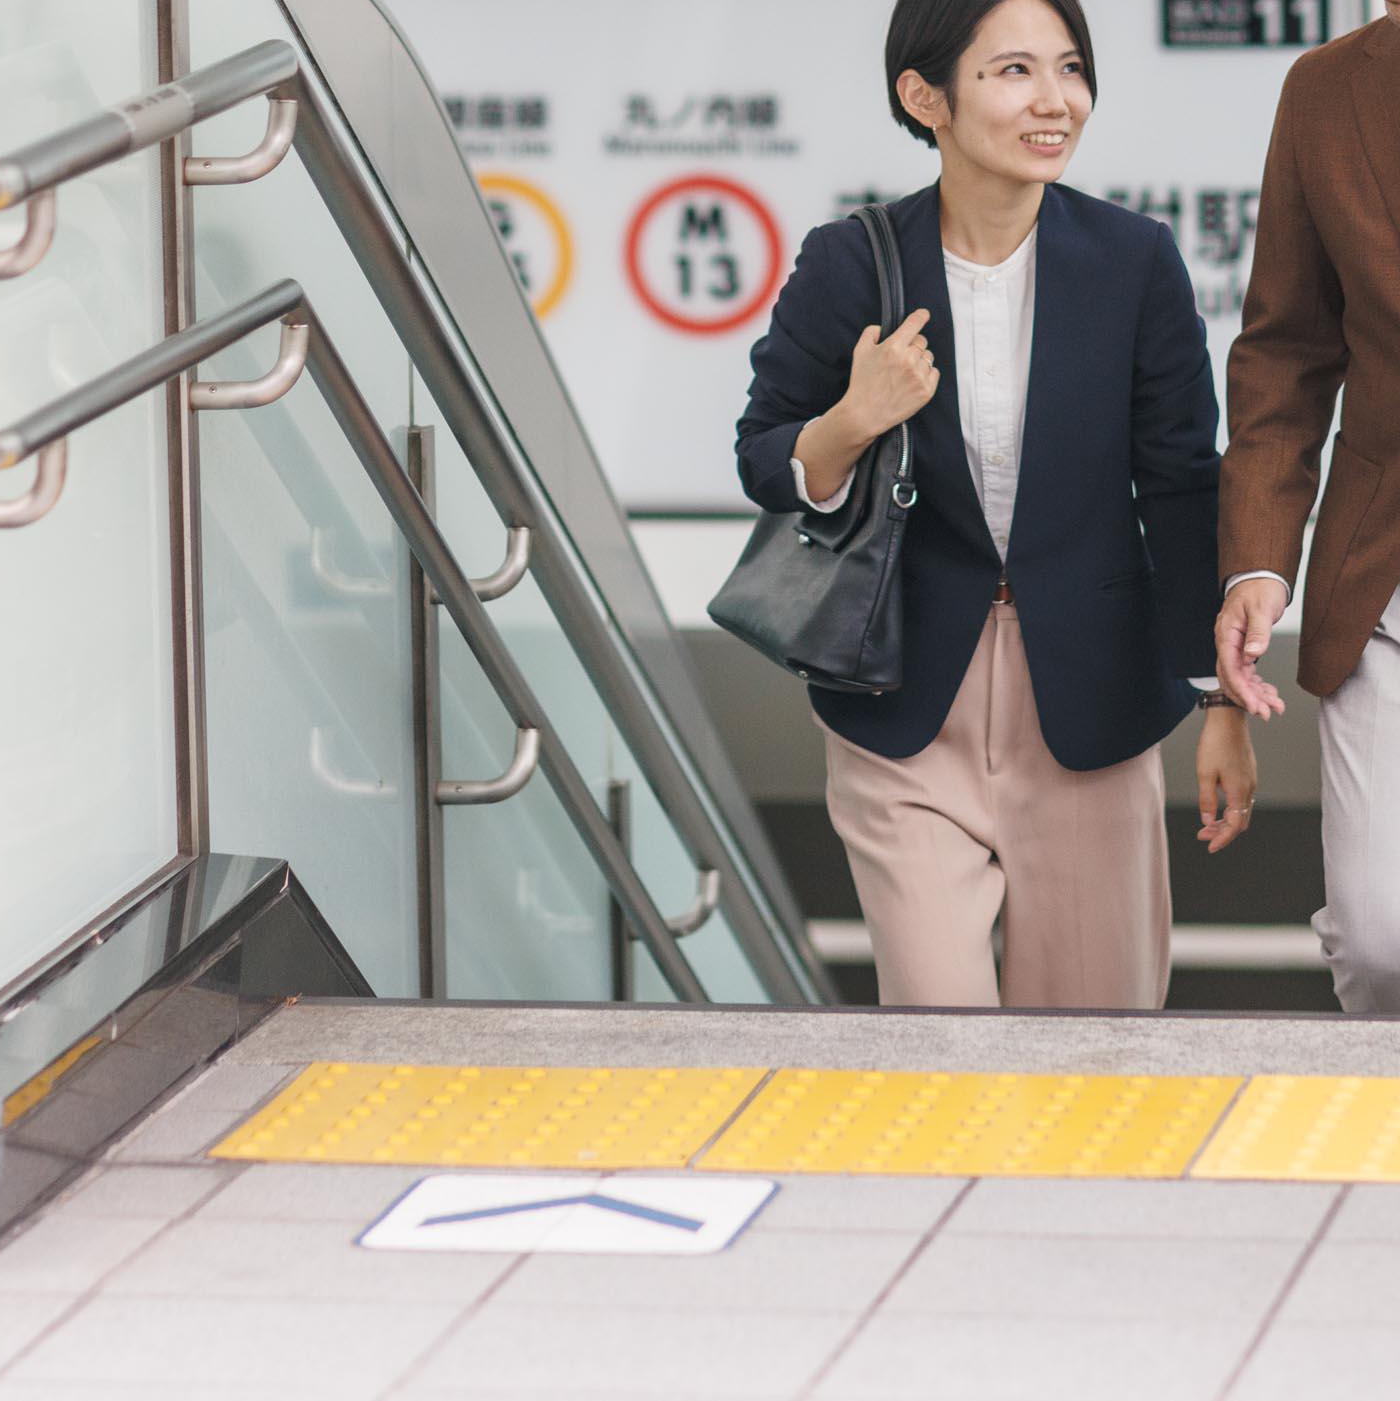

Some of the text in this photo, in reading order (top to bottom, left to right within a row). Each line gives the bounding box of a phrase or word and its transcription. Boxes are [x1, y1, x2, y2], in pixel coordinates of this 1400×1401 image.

[624, 94, 778, 130] 丸ノ内線
[679, 202, 729, 243] M
[674, 252, 742, 299] 13
